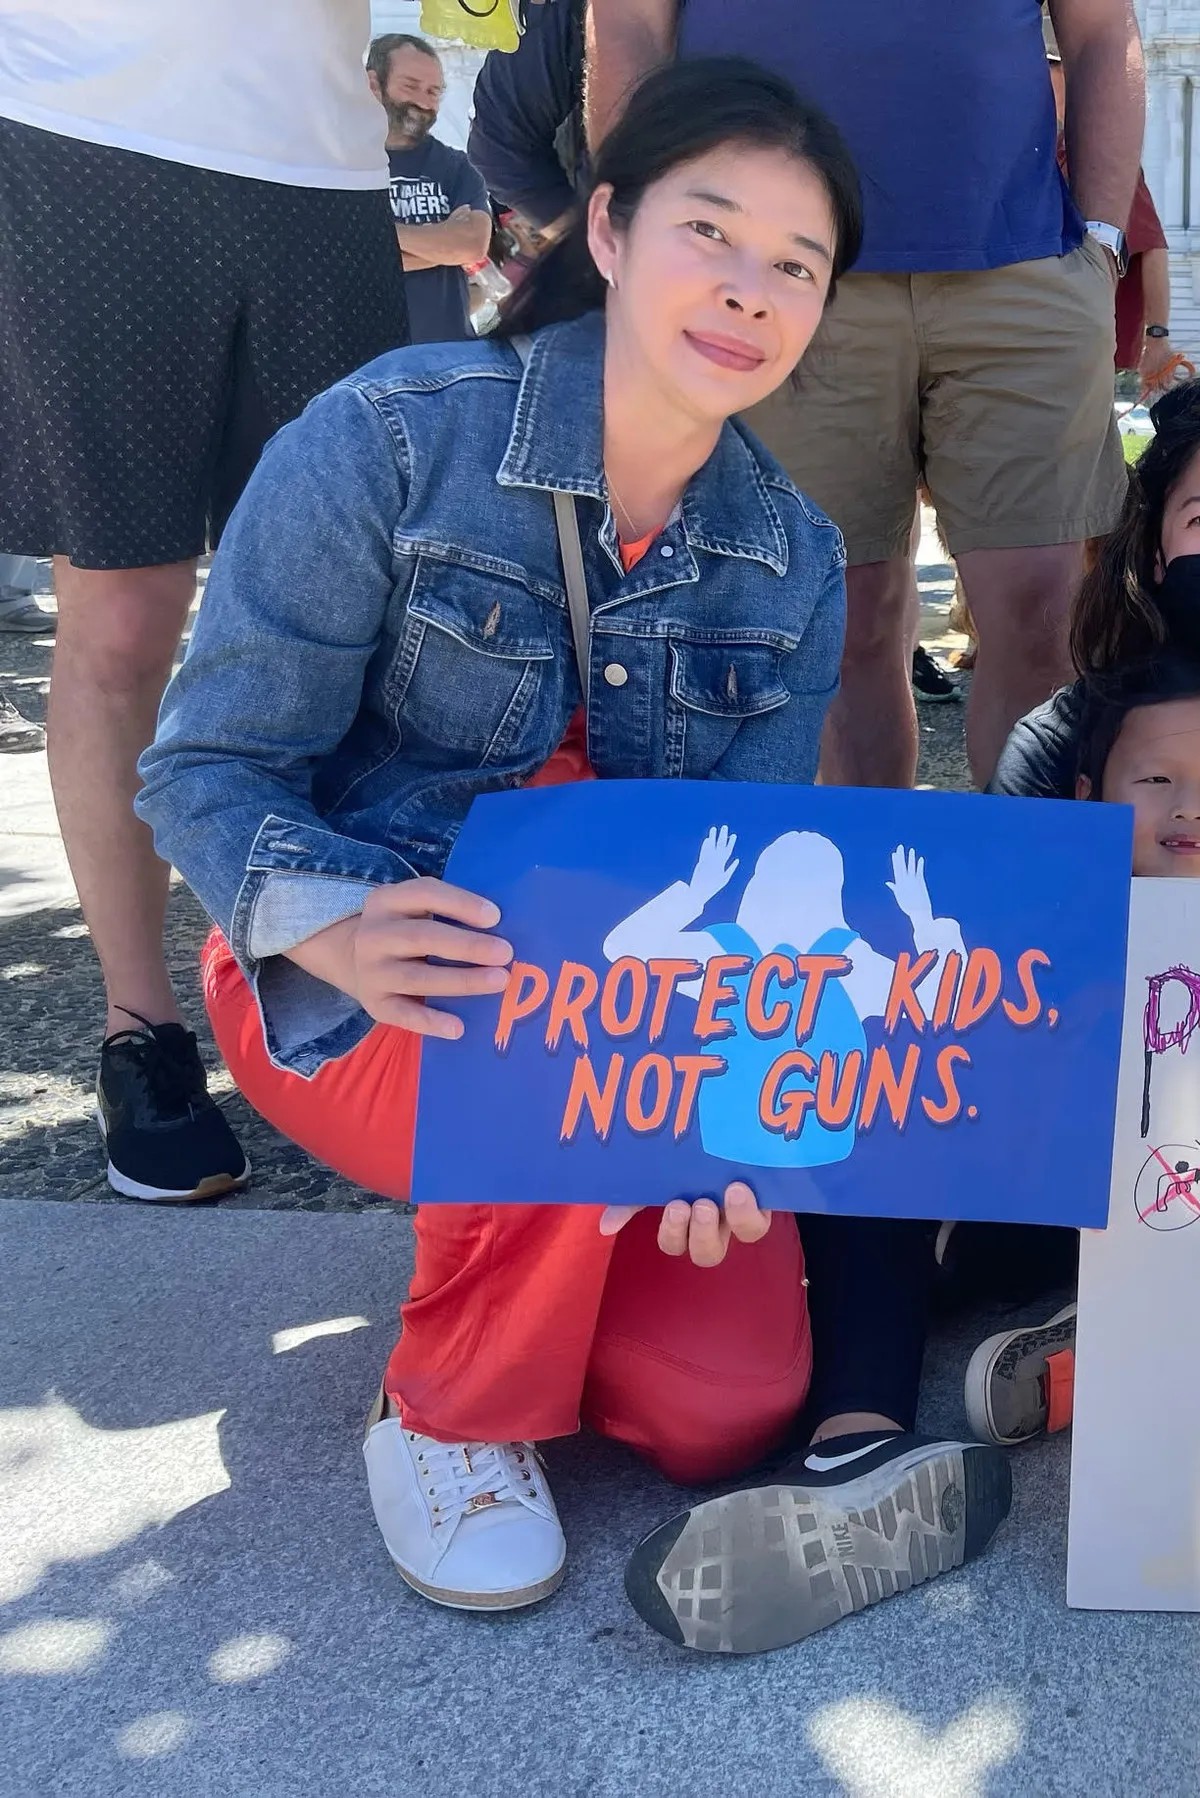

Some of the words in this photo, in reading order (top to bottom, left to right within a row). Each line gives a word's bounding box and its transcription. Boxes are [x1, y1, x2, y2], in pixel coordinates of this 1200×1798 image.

[494, 952, 853, 1052] PROTECT
[884, 948, 1060, 1035] KIDS,
[560, 1051, 728, 1144] NOT
[759, 1043, 979, 1139] GUNS.
[831, 1522, 855, 1558] NIKE
